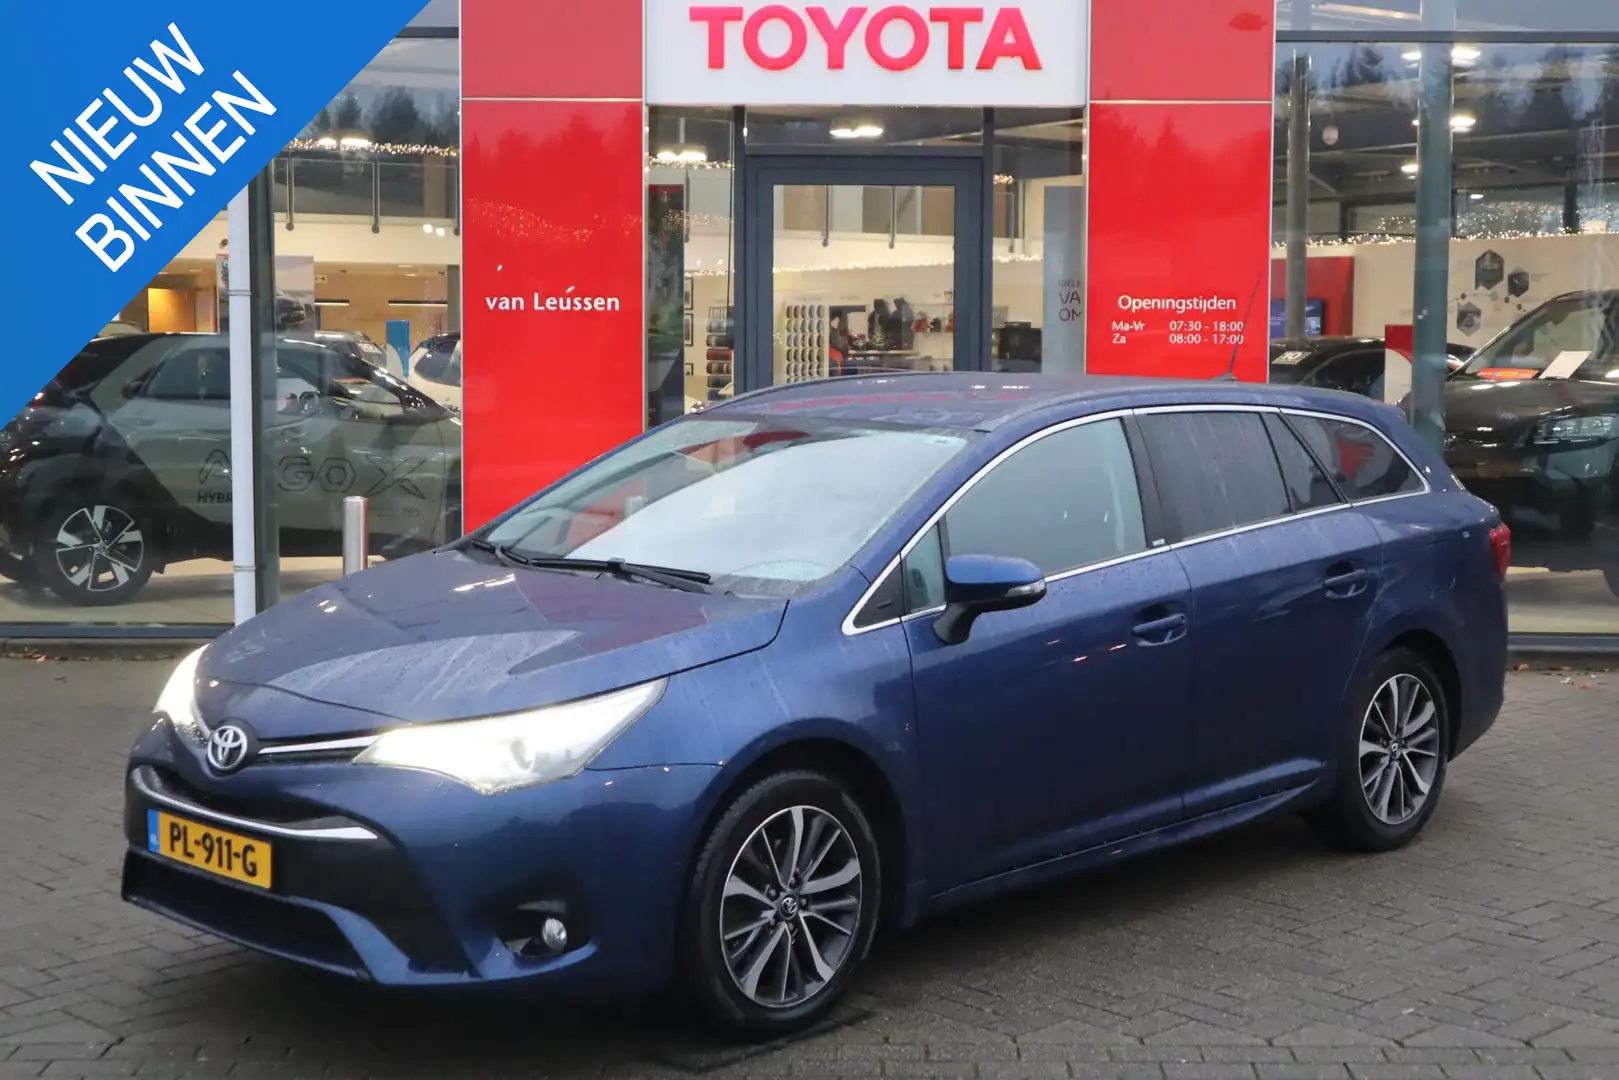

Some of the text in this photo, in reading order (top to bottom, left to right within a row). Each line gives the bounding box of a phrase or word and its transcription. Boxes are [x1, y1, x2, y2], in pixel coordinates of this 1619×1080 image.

[689, 4, 1043, 71] TOYOTA
[485, 296, 525, 311] van
[1117, 294, 1237, 314] Openingstijden
[1111, 320, 1145, 331] Ma-Vr
[1169, 320, 1201, 331] 07:30
[1212, 320, 1244, 331] 18:00
[1112, 333, 1126, 344] Za
[1169, 333, 1201, 344] 08:00
[1212, 333, 1244, 344] 17:00
[199, 449, 356, 494] AGO
[197, 490, 233, 504] HYBR
[169, 820, 258, 878] PL-911-G
